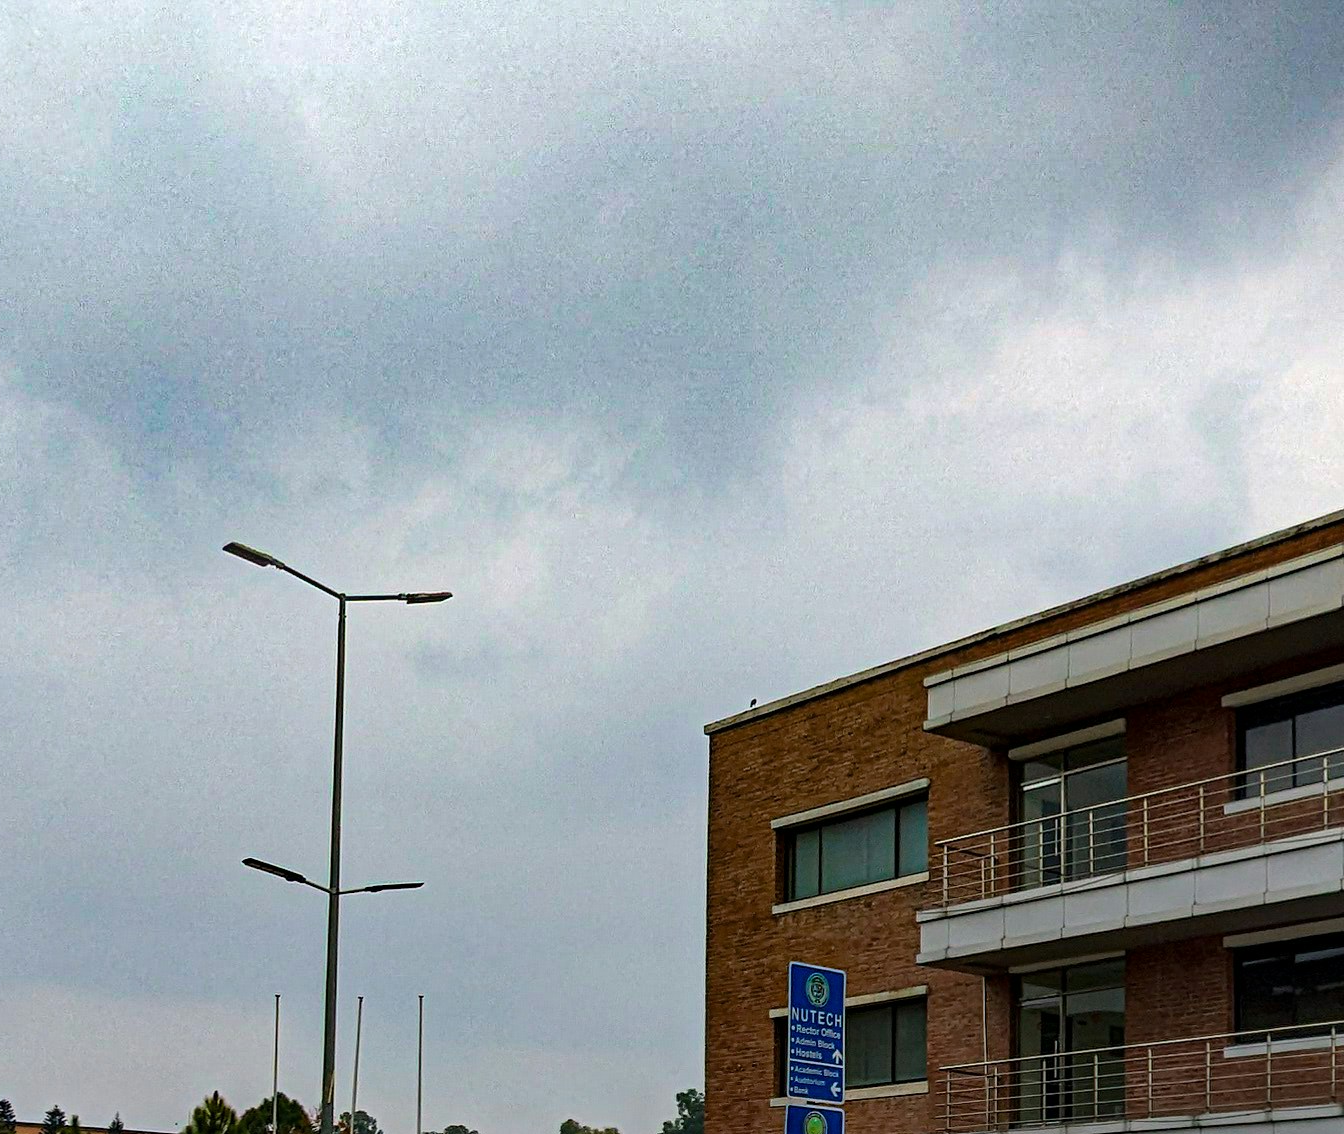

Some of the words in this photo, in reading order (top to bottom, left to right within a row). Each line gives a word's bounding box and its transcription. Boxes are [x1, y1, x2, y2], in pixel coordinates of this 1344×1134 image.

[791, 1007, 842, 1027] NUTECH
[796, 1024, 819, 1035] Rector
[821, 1028, 841, 1039] Office
[795, 1037, 816, 1046] Admin
[817, 1040, 835, 1049] Block
[796, 1048, 822, 1059] Hostels
[794, 1065, 823, 1075] Academic
[823, 1069, 839, 1078] Block
